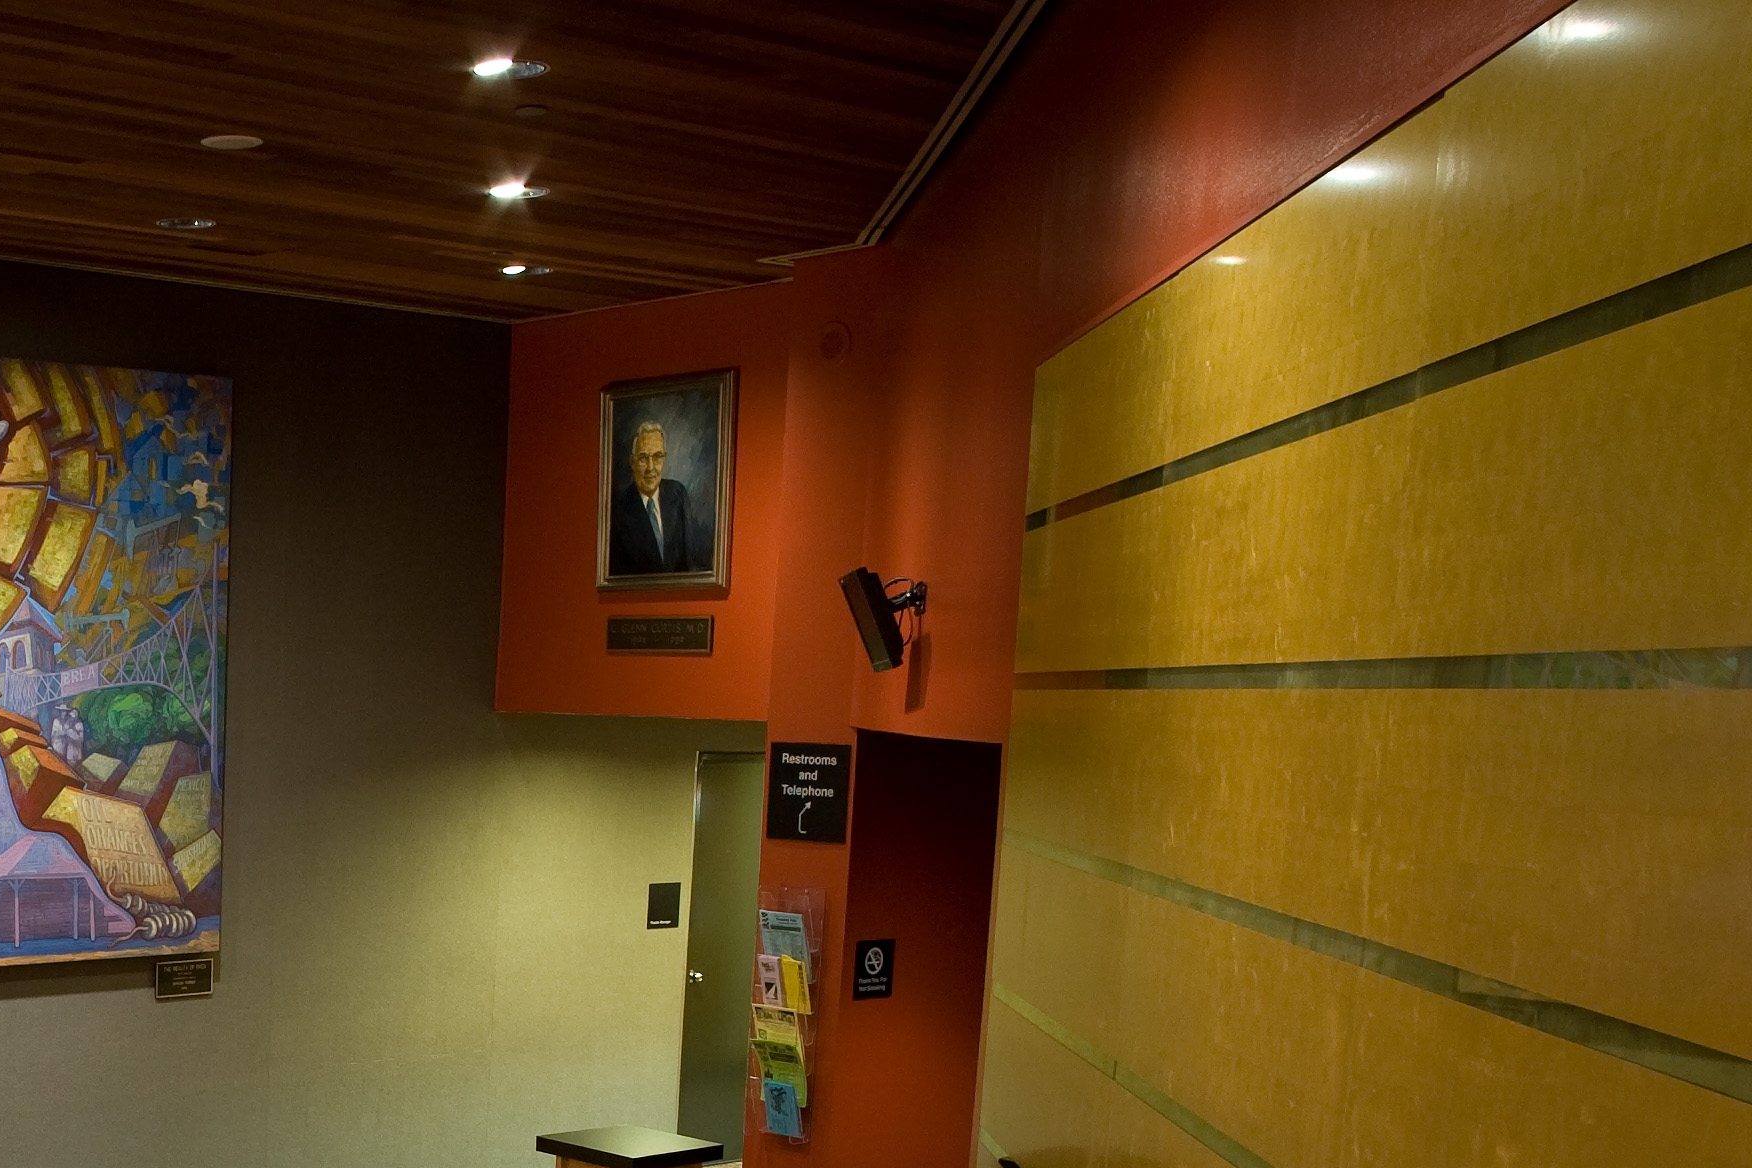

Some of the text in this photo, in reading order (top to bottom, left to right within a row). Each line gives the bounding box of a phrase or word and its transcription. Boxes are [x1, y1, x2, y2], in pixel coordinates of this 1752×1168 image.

[62, 665, 96, 686] BREA
[781, 752, 838, 766] Restrooms
[798, 770, 818, 781] and
[781, 784, 834, 798] Telephone
[81, 796, 113, 823] OIL
[86, 824, 147, 855] ORANGES
